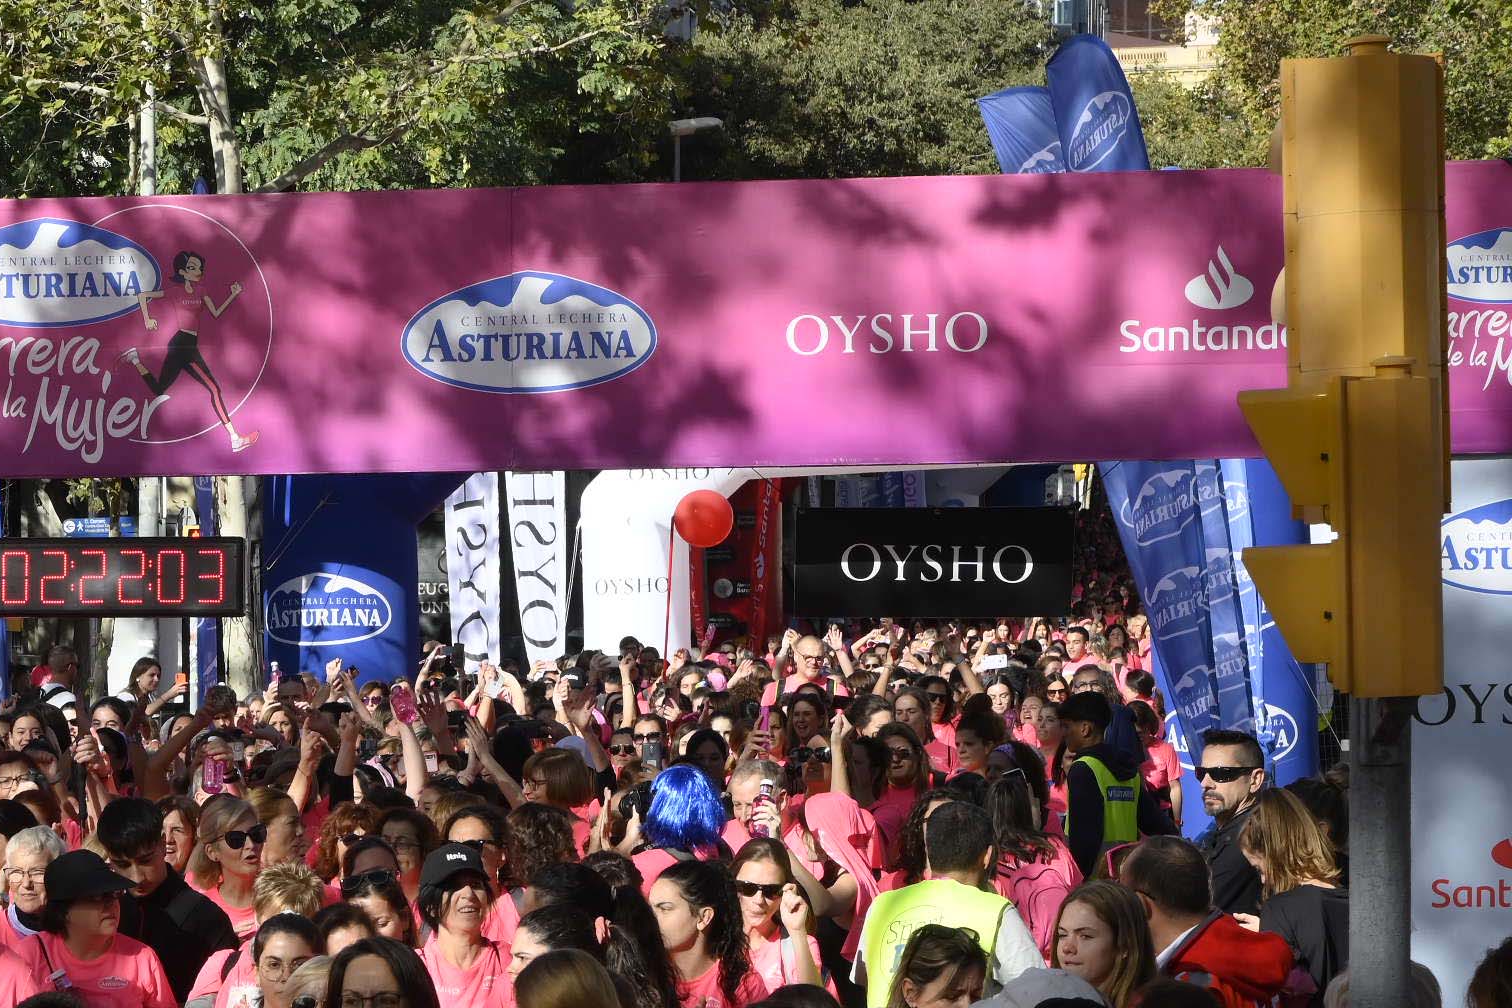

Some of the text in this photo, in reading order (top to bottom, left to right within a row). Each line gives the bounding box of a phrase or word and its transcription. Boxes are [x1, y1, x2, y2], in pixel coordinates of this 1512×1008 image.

[62, 254, 136, 267] LECHERA
[460, 311, 629, 327] CENTRAL LECHERA
[786, 311, 988, 356] OYSHO
[1119, 319, 1289, 353] Santand
[421, 318, 637, 363] ASTURIANA
[1, 379, 27, 419] la
[22, 370, 171, 464] Mujer
[1, 550, 224, 604] 02:22:03
[840, 543, 1034, 584] OYSHO
[270, 606, 382, 629] ASTURIANA
[326, 597, 378, 607] LECHERA
